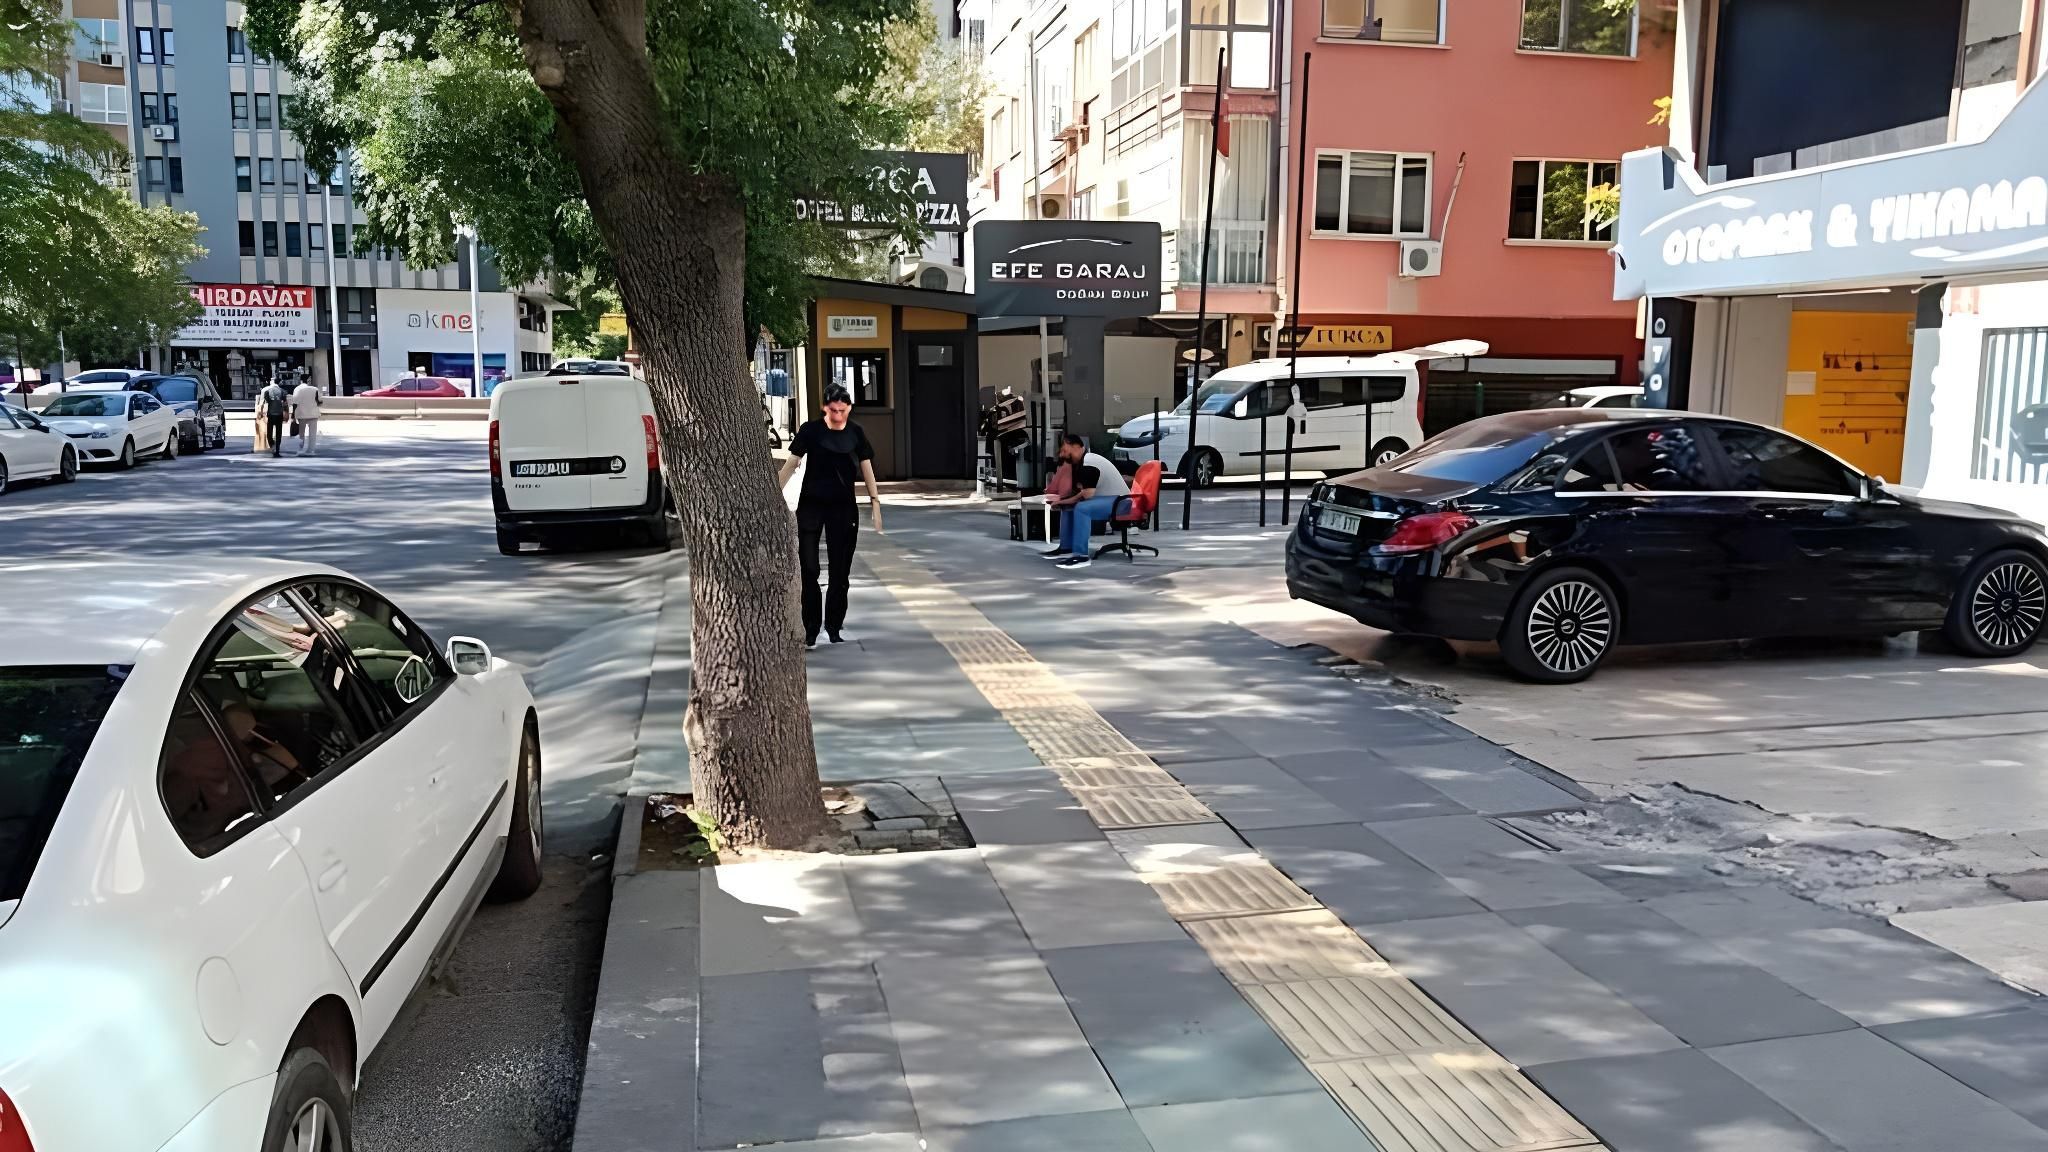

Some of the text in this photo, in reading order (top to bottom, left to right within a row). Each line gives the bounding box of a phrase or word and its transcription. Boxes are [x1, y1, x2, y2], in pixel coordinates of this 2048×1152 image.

[1869, 176, 2048, 243] YIKAMA
[991, 262, 1146, 279] EFE GARAJ
